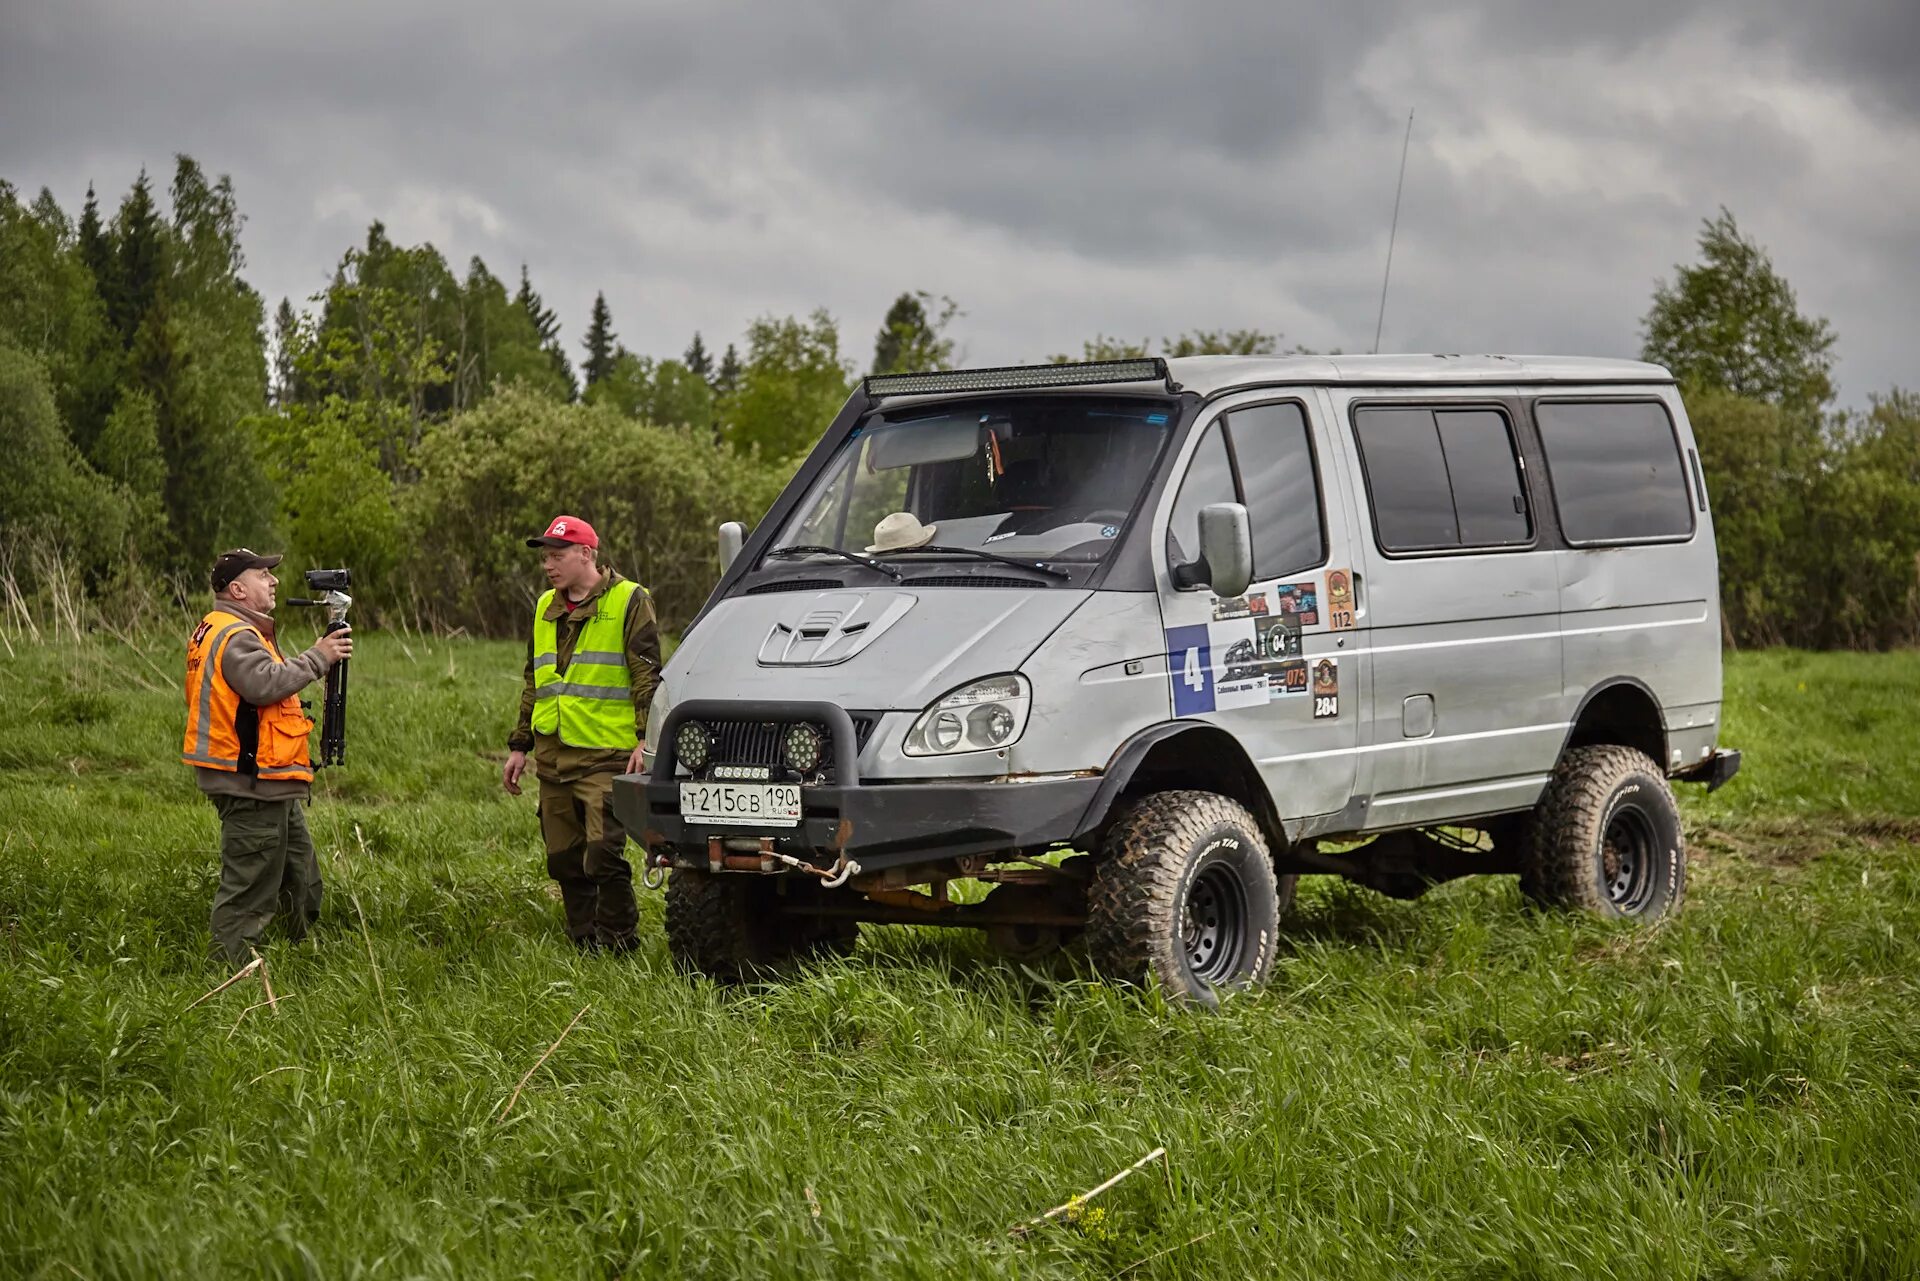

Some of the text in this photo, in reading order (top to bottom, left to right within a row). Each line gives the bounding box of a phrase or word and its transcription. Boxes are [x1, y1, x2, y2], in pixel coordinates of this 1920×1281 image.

[1333, 611, 1352, 628] 112
[1273, 634, 1285, 652] 04
[1184, 646, 1205, 692] 4
[1287, 668, 1306, 686] 075
[1315, 696, 1337, 716] 284
[766, 788, 795, 807] 190
[772, 807, 788, 815] RUS
[1222, 838, 1239, 850] T/A
